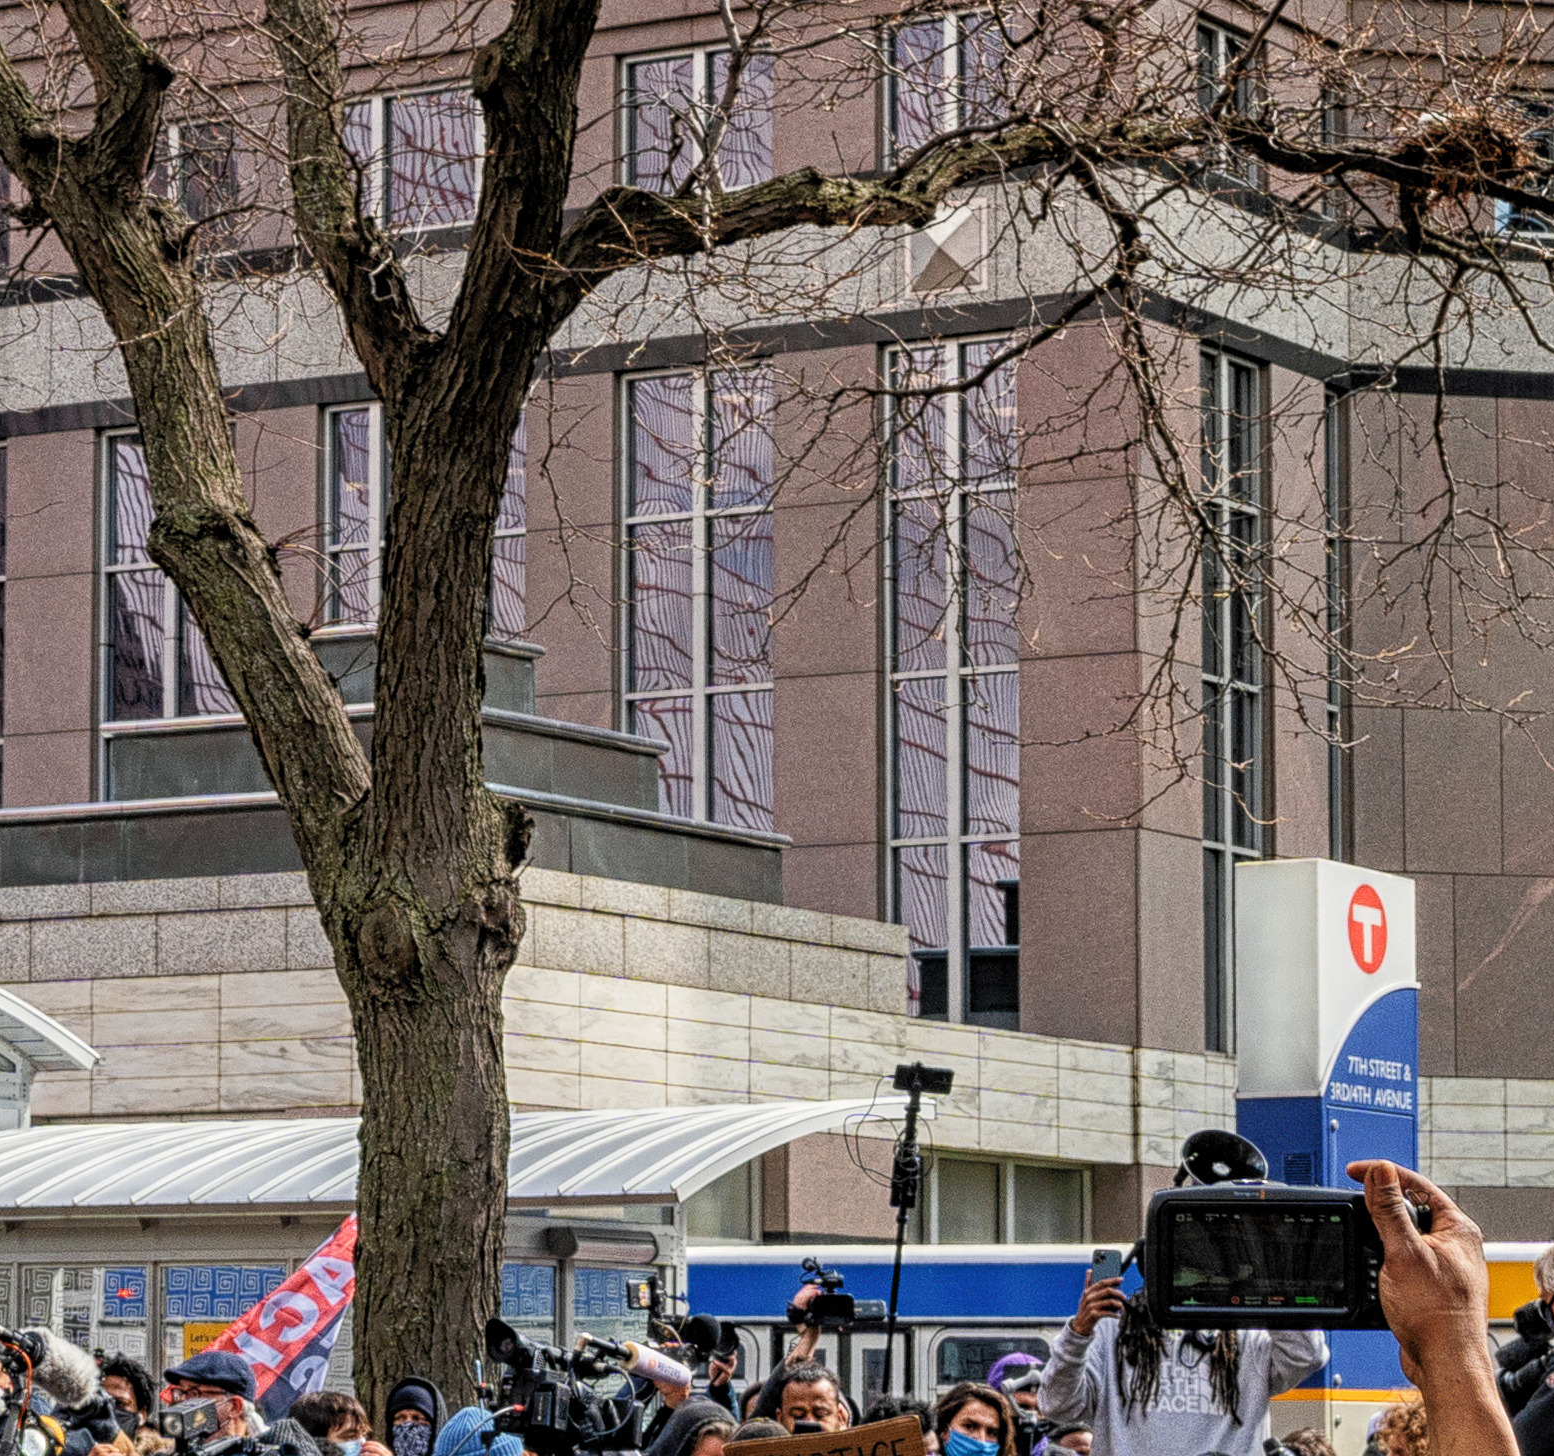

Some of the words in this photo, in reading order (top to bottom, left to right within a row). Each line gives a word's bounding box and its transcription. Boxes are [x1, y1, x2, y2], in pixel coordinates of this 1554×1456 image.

[1353, 905, 1382, 963] T
[1347, 1056, 1368, 1077] 7TH
[1369, 1057, 1402, 1080] STREET
[1404, 1064, 1412, 1081] &
[1374, 1090, 1413, 1111] AVENUE
